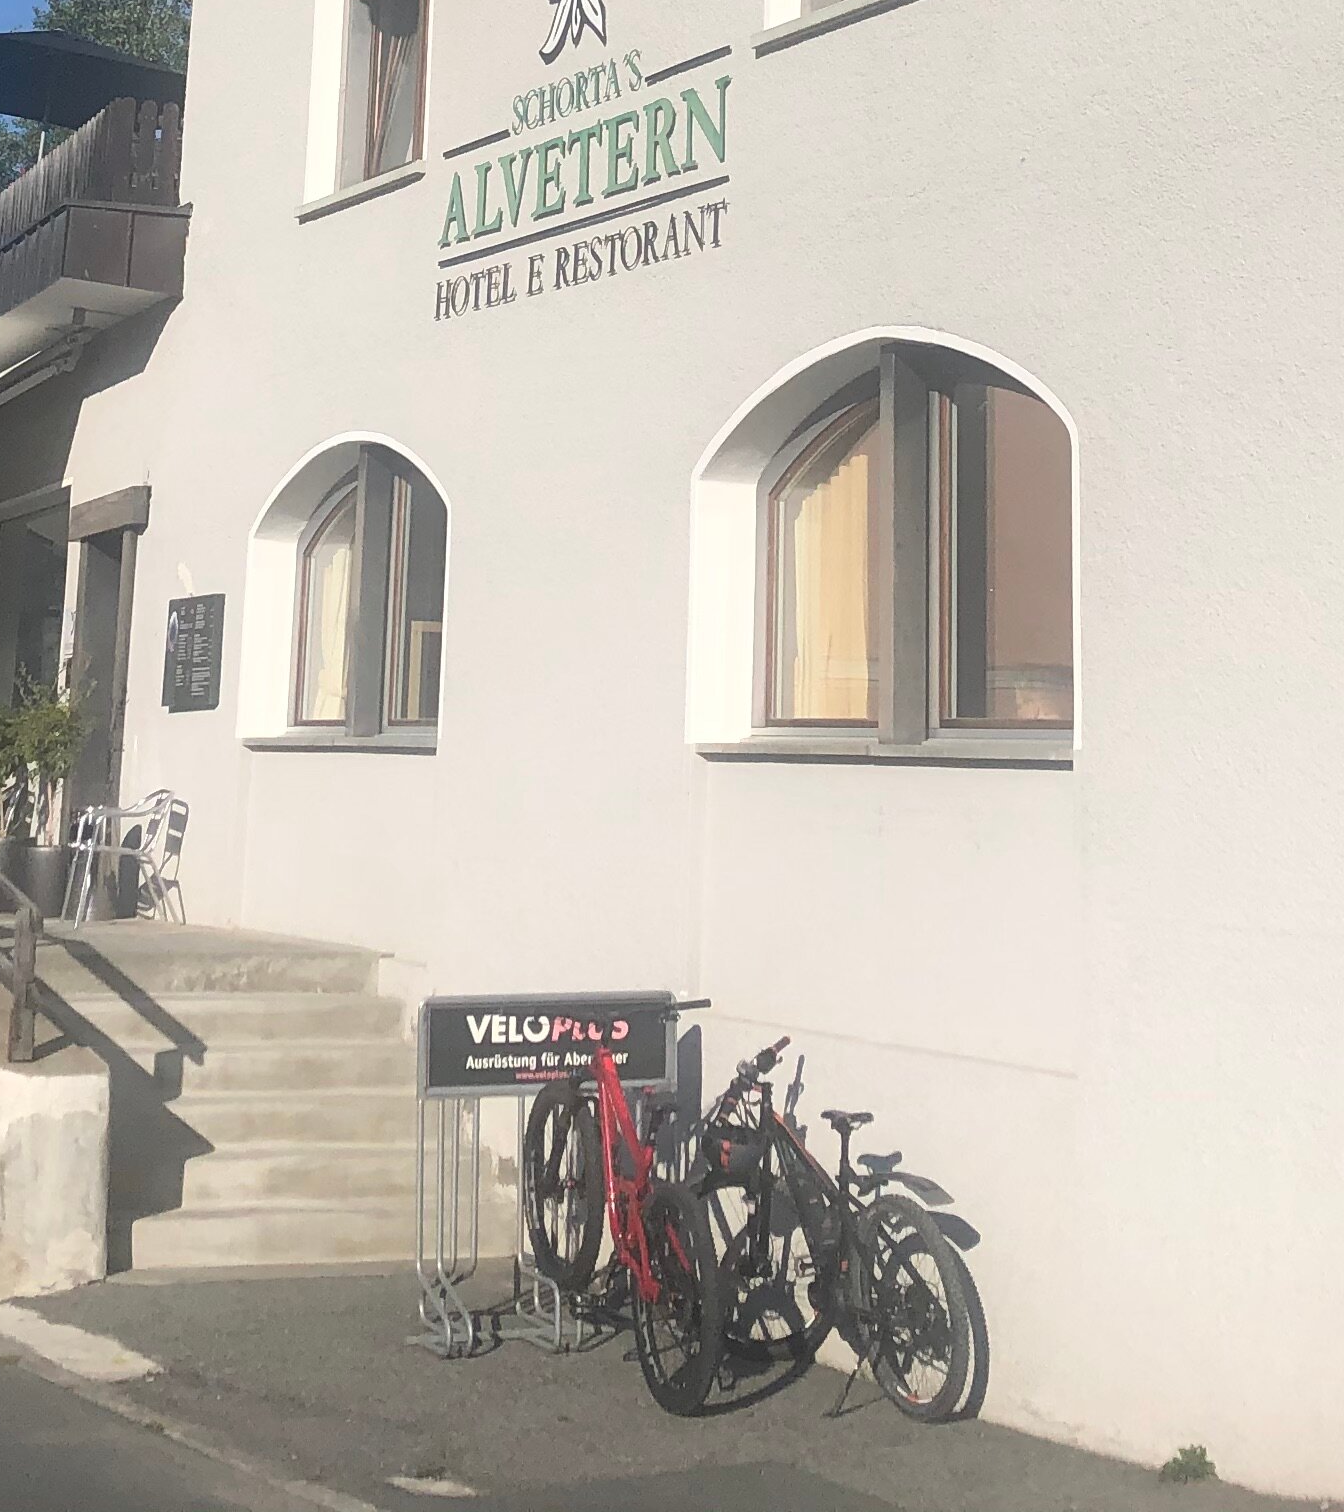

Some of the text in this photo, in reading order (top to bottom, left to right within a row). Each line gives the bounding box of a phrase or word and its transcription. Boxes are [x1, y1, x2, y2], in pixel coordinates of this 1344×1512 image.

[511, 49, 644, 135] SCHORTA'S
[438, 75, 732, 249] ALVETERN
[434, 198, 730, 321] HOTEL E RESTORANT
[465, 1050, 629, 1071] Ausrüstung für Abeer
